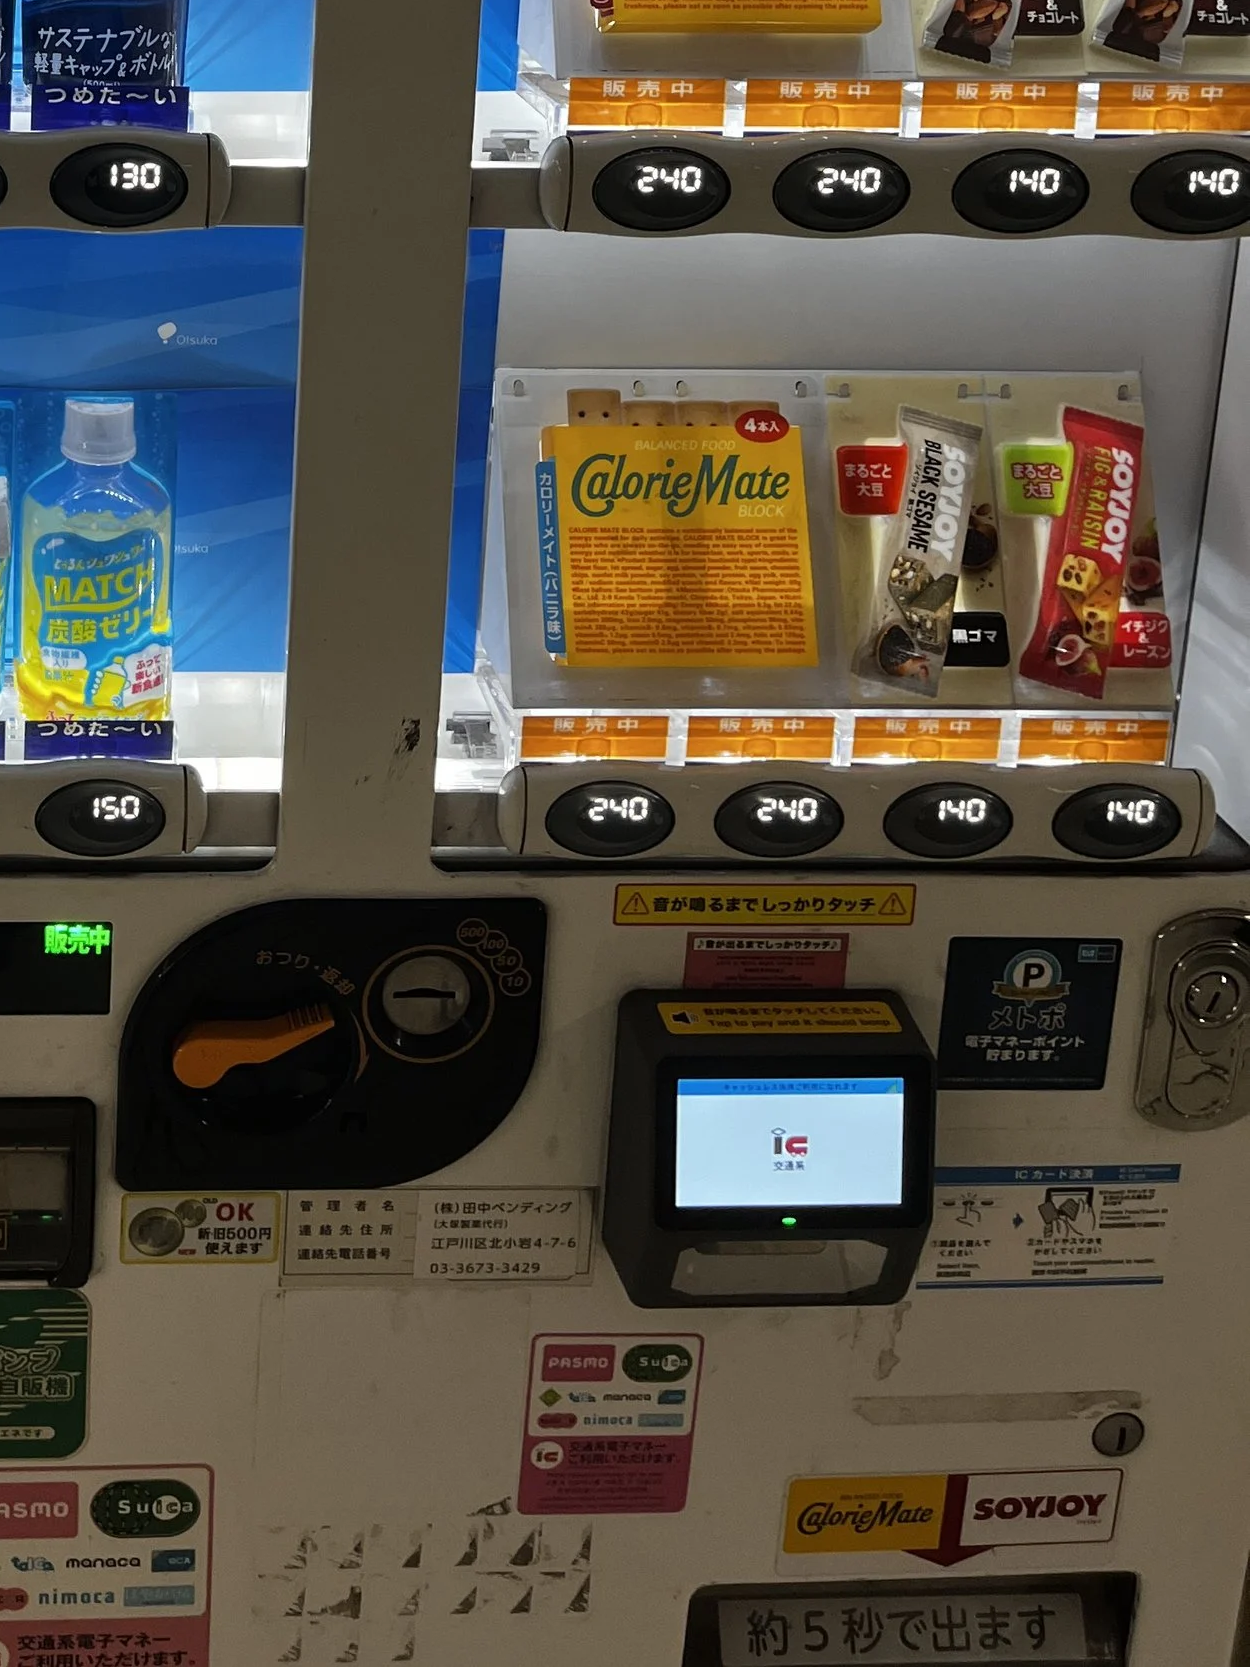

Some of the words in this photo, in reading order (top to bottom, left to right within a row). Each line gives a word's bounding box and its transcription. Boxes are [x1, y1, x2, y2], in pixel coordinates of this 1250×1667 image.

[1026, 9, 1082, 26] チョコレート
[602, 78, 695, 99] 販売中
[109, 161, 162, 190] 130
[636, 165, 702, 194] 240
[816, 167, 882, 196] 240
[1008, 168, 1061, 196] 140
[843, 462, 893, 480] まるごと
[570, 452, 791, 518] CalorieMate
[856, 481, 885, 498] 大豆
[1121, 618, 1169, 635] イチジク
[951, 627, 998, 644] 黒ゴマ
[1123, 643, 1172, 660] レーズン
[885, 718, 972, 735] 販売中
[92, 795, 141, 821] 150
[588, 796, 649, 823] 240
[937, 797, 987, 823] 140
[1106, 798, 1156, 825] 140
[653, 896, 876, 914] 音が鳴るまでしっかりタッチ
[44, 924, 111, 955] 販売中
[964, 1034, 1086, 1049] 電子マネーポイント
[216, 1202, 255, 1222] OK
[205, 1241, 263, 1255] 使えます
[430, 1236, 577, 1252] 江戸川区北小岩4-7-6
[297, 1248, 391, 1261] 連絡先電話番号
[429, 1261, 541, 1275] 03-3673-3429
[548, 1356, 610, 1369] PASMO
[973, 1493, 1108, 1521] SOYJOY
[65, 1556, 141, 1569] manaca
[38, 1588, 115, 1605] nimoca
[17, 1634, 171, 1651] 交通系電子マネー
